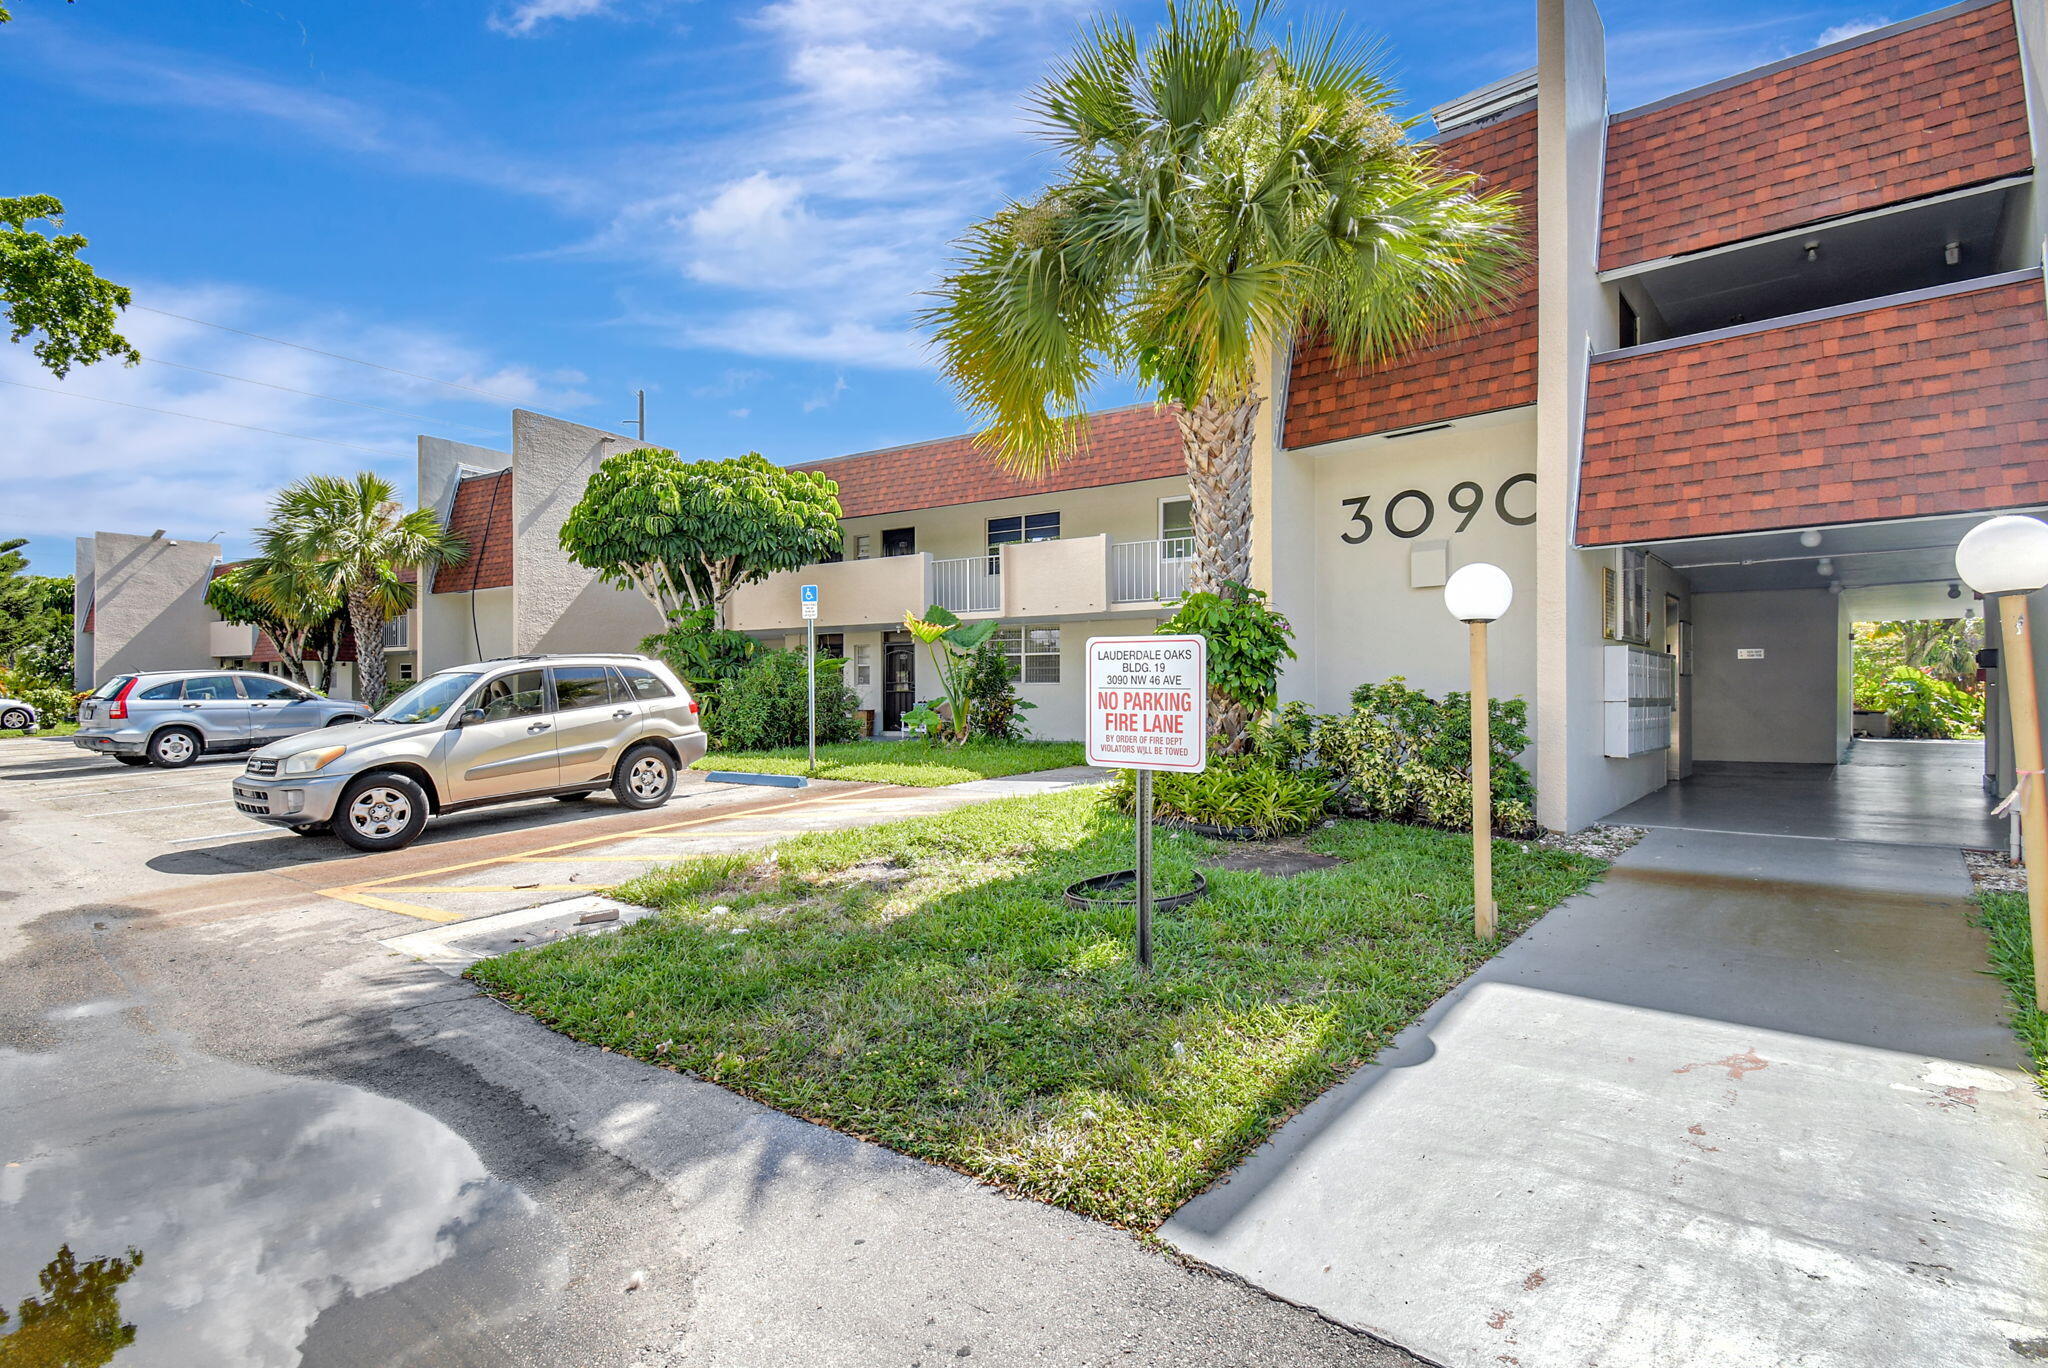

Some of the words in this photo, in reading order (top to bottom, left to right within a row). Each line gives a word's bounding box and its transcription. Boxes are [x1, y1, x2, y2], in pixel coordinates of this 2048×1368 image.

[1341, 473, 1537, 544] 3090
[1098, 651, 1161, 660] LAUDERDALE
[1164, 650, 1192, 660] OAKS
[1122, 663, 1151, 672] BLDG.
[1155, 663, 1165, 672] 19
[1107, 675, 1128, 685] 3090
[1131, 675, 1147, 685] NW
[1149, 675, 1160, 685] 46
[1163, 675, 1181, 685] AVE
[1098, 692, 1118, 709] NO
[1124, 692, 1191, 711] PARKING
[1106, 713, 1137, 730] FIRE
[1143, 714, 1183, 733] LANE
[1116, 735, 1137, 743] ORDER
[1166, 737, 1182, 745] DEPT
[1101, 745, 1135, 753] VIOLATORS
[1137, 746, 1152, 755] WILL
[1165, 747, 1188, 756] TOWED
